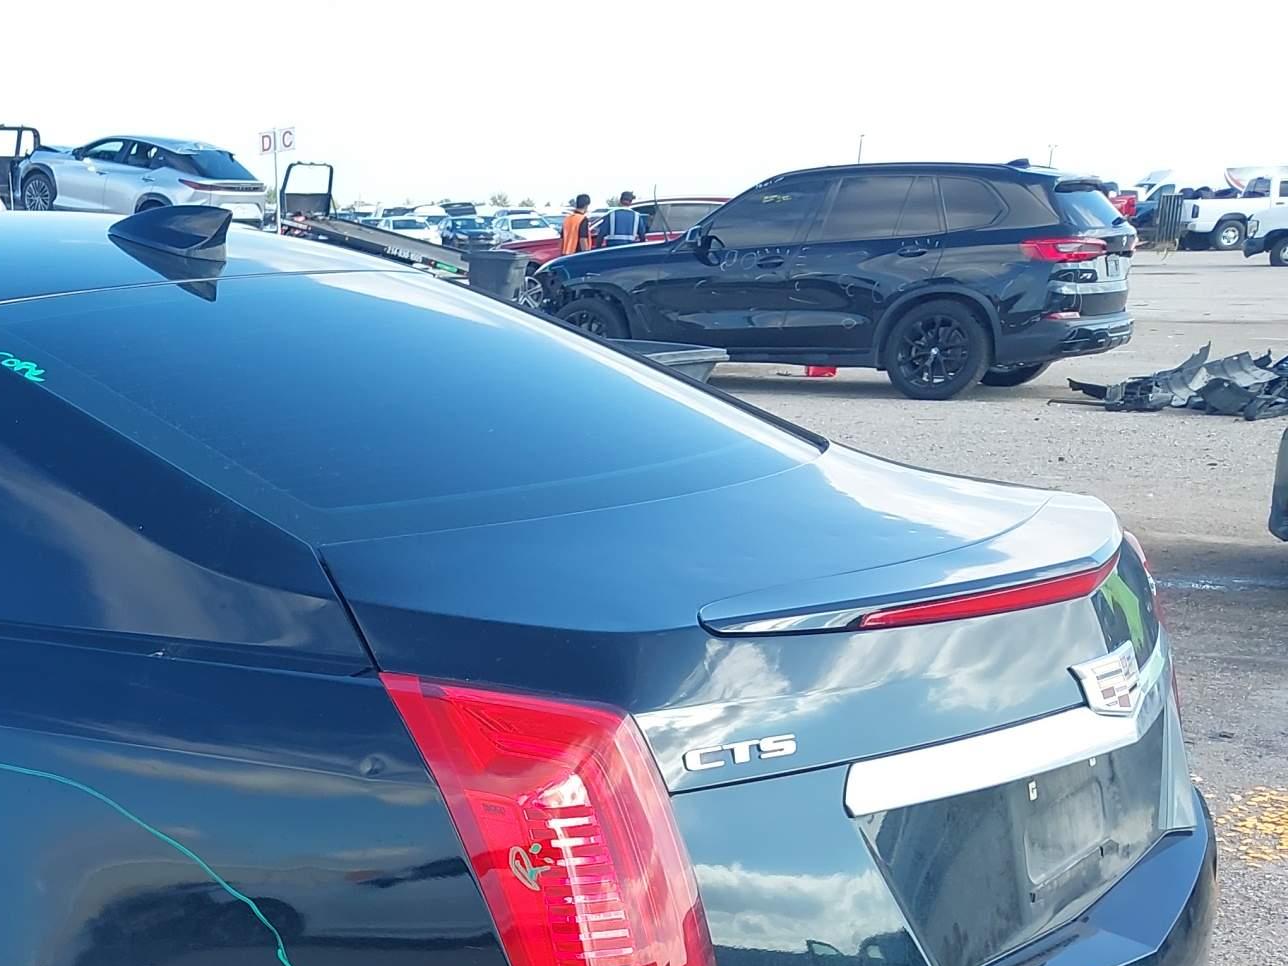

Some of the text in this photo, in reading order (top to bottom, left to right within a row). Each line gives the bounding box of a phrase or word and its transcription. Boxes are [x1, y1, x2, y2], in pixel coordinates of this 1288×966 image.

[261, 134, 272, 152] D
[282, 130, 293, 148] C
[682, 733, 798, 772] CTS
